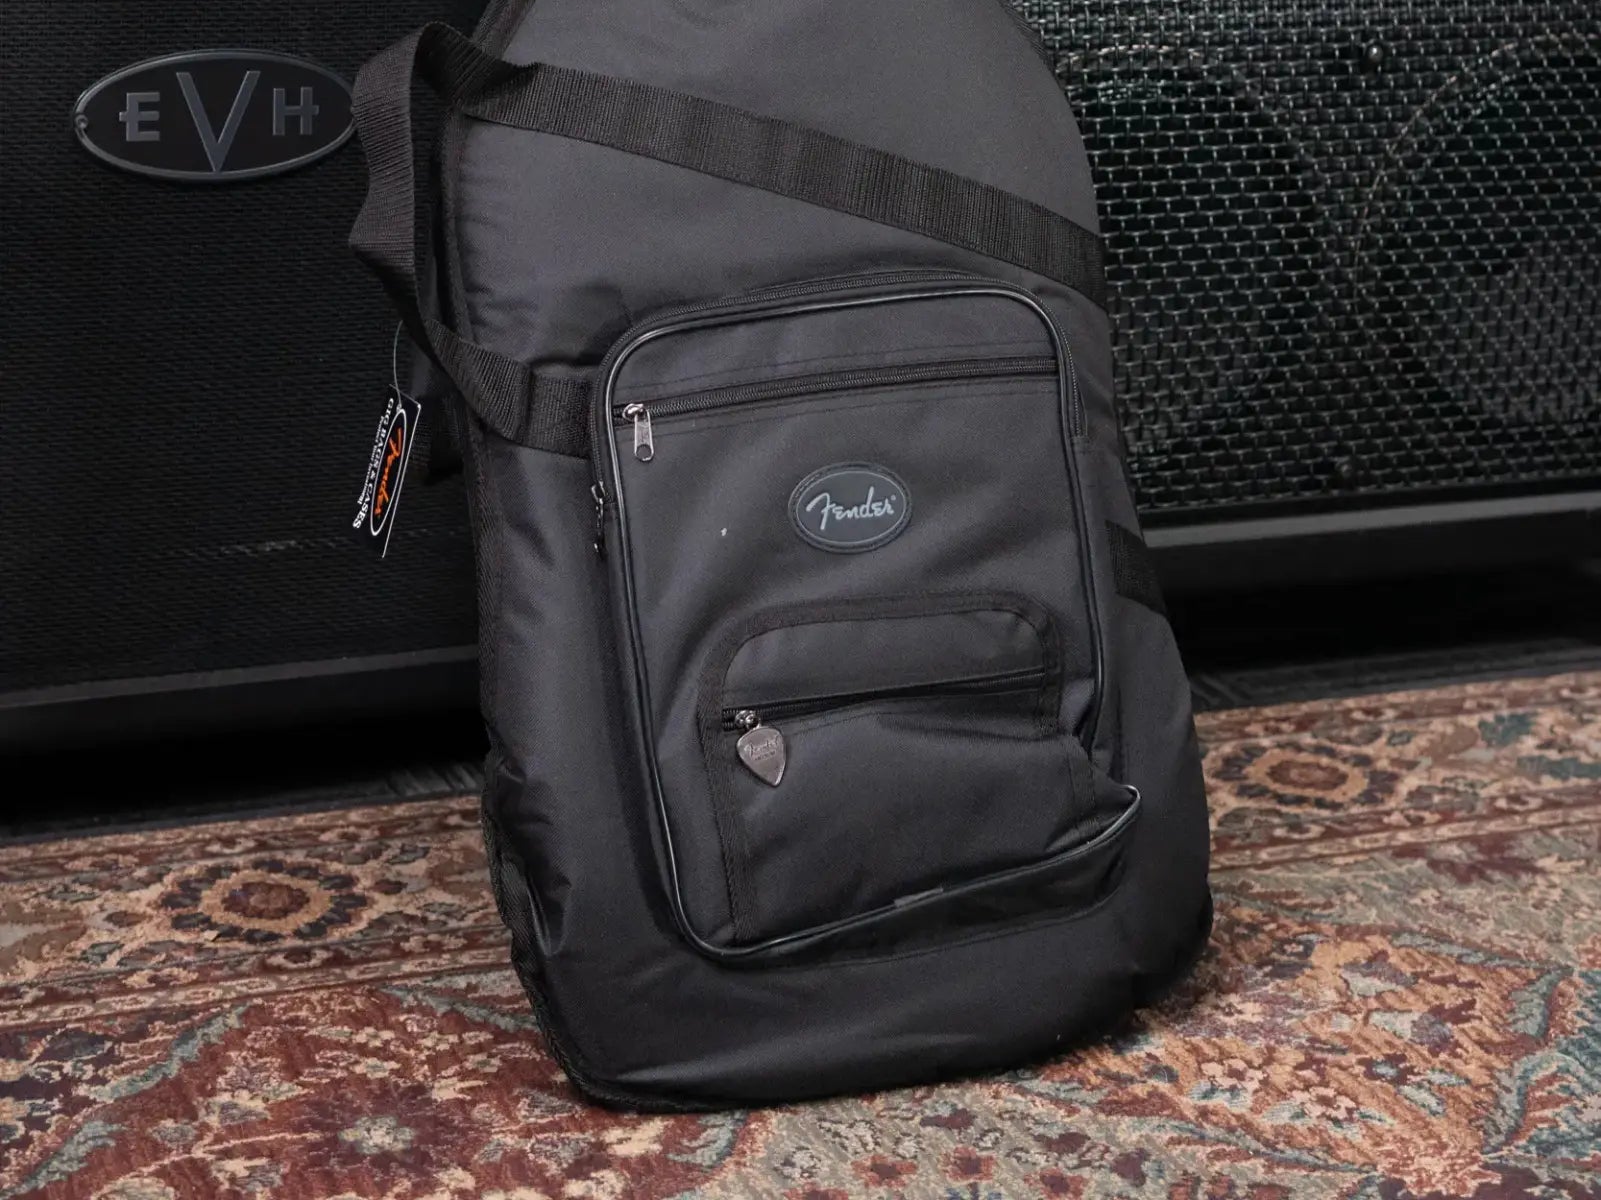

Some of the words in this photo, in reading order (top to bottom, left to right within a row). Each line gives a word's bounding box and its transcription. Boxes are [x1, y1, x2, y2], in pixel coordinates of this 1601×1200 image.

[119, 70, 320, 173] EVH
[384, 398, 394, 425] GIG
[374, 428, 386, 468] BAGS
[352, 483, 373, 529] CASES
[806, 486, 896, 530] Fender
